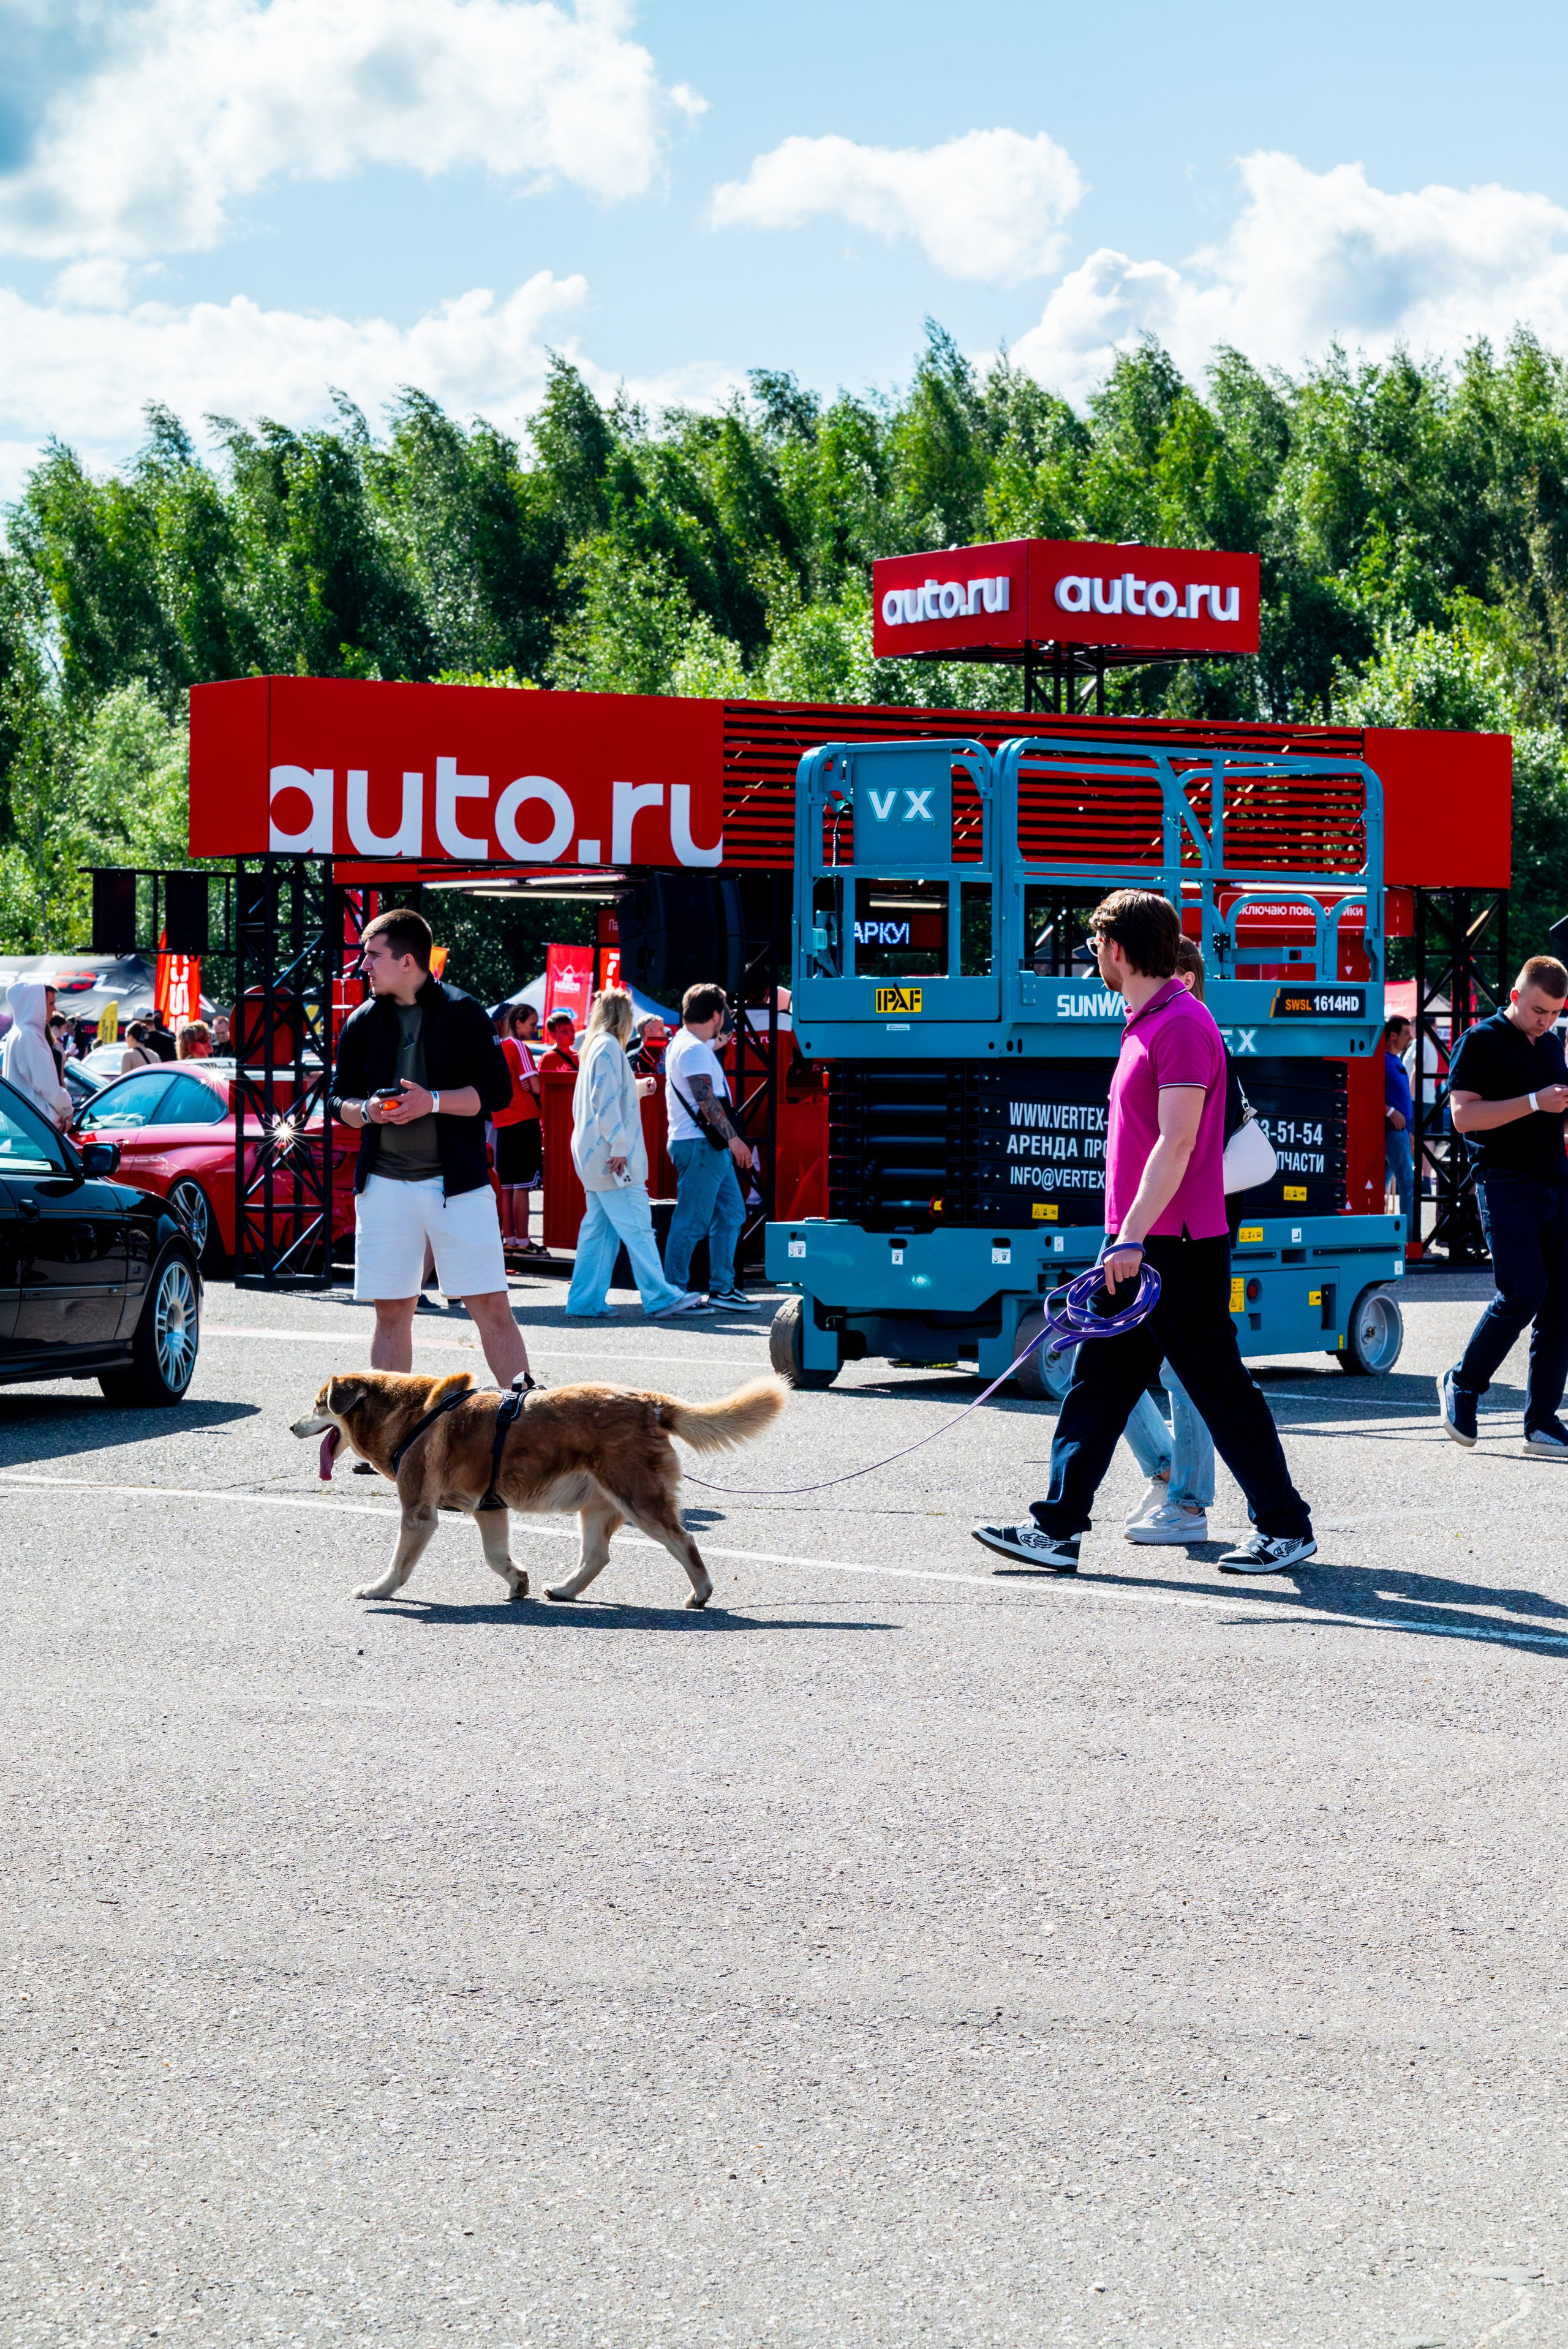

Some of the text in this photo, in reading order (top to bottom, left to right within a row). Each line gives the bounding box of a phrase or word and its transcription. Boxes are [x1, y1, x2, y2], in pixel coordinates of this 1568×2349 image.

[882, 576, 1009, 626] auto.ru
[1054, 573, 1239, 621] auto.ru
[270, 756, 722, 867] auto.ru
[1239, 905, 1287, 916] ключаю
[854, 922, 909, 944] АРКУ
[878, 982, 921, 1011] IPAF
[1285, 995, 1359, 1011] SWSL 1614HD
[1254, 1119, 1323, 1145] 3-51-54
[1006, 1134, 1078, 1159] АРЕНДА
